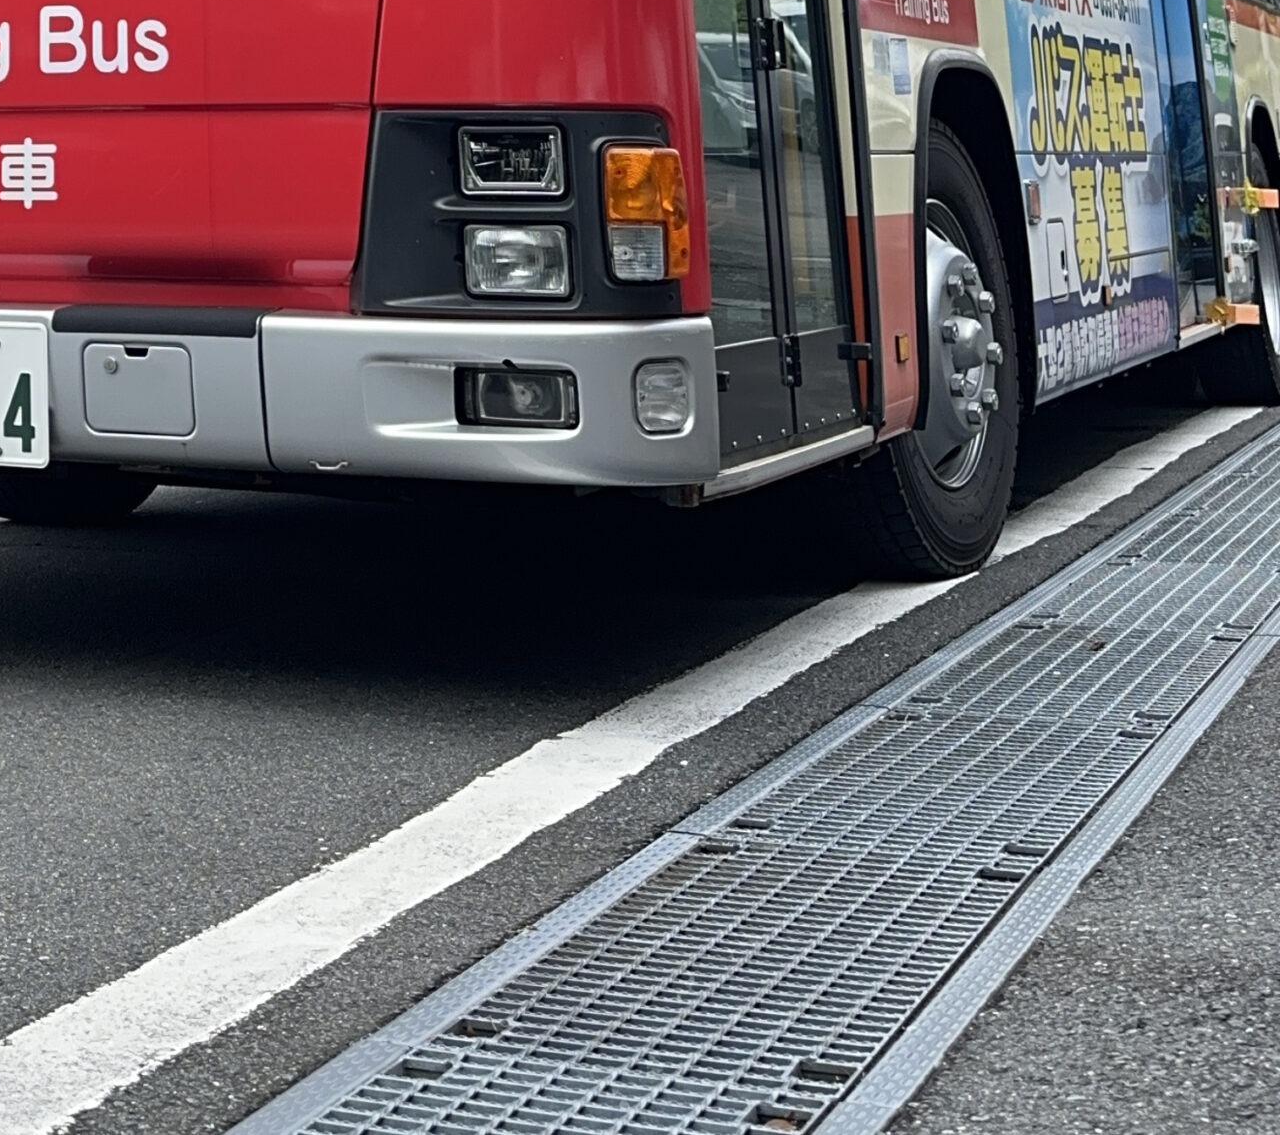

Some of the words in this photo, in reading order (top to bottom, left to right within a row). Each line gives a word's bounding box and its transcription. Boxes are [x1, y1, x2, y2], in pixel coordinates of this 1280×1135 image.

[39, 5, 170, 74] Bus
[1030, 23, 1147, 161] バス運転士
